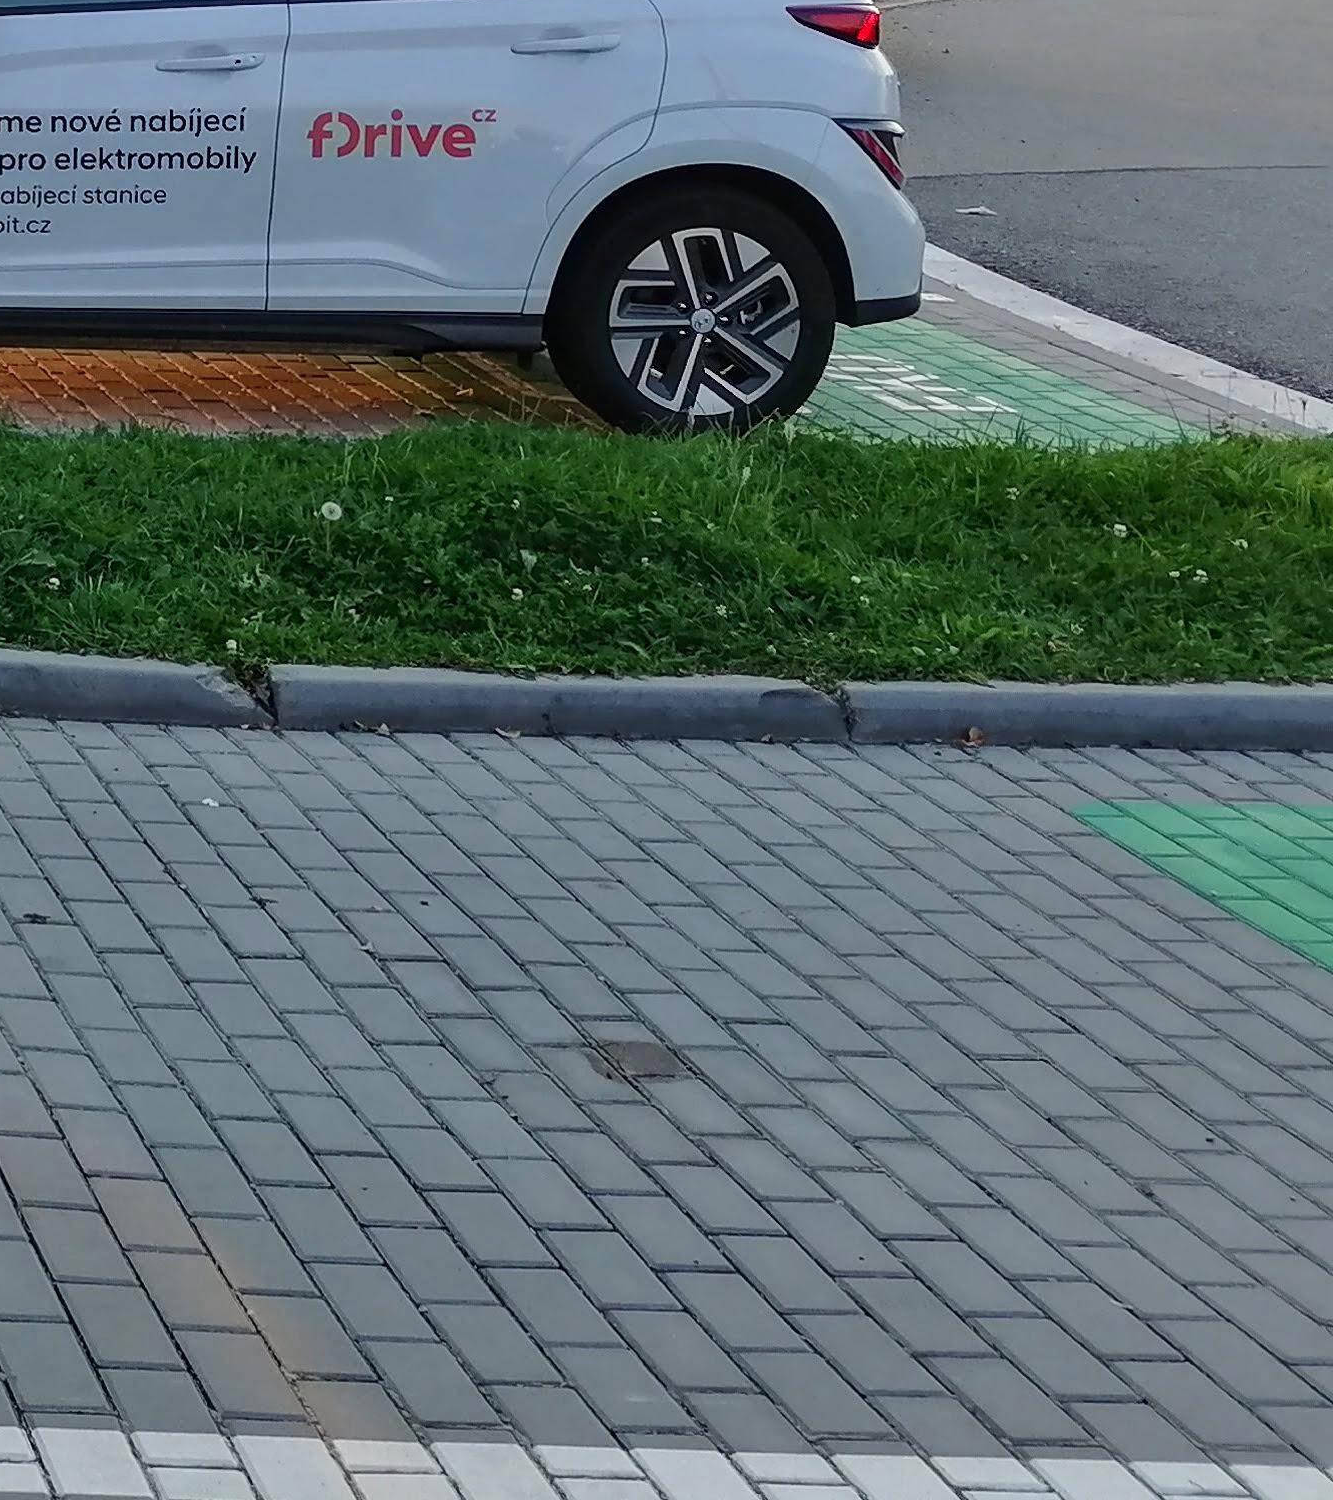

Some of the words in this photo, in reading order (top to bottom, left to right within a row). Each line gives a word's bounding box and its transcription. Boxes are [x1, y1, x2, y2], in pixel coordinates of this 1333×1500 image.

[50, 108, 121, 133] nové
[130, 107, 247, 138] nabíjecí
[54, 145, 257, 174] elektromobily
[83, 184, 167, 204] stanice
